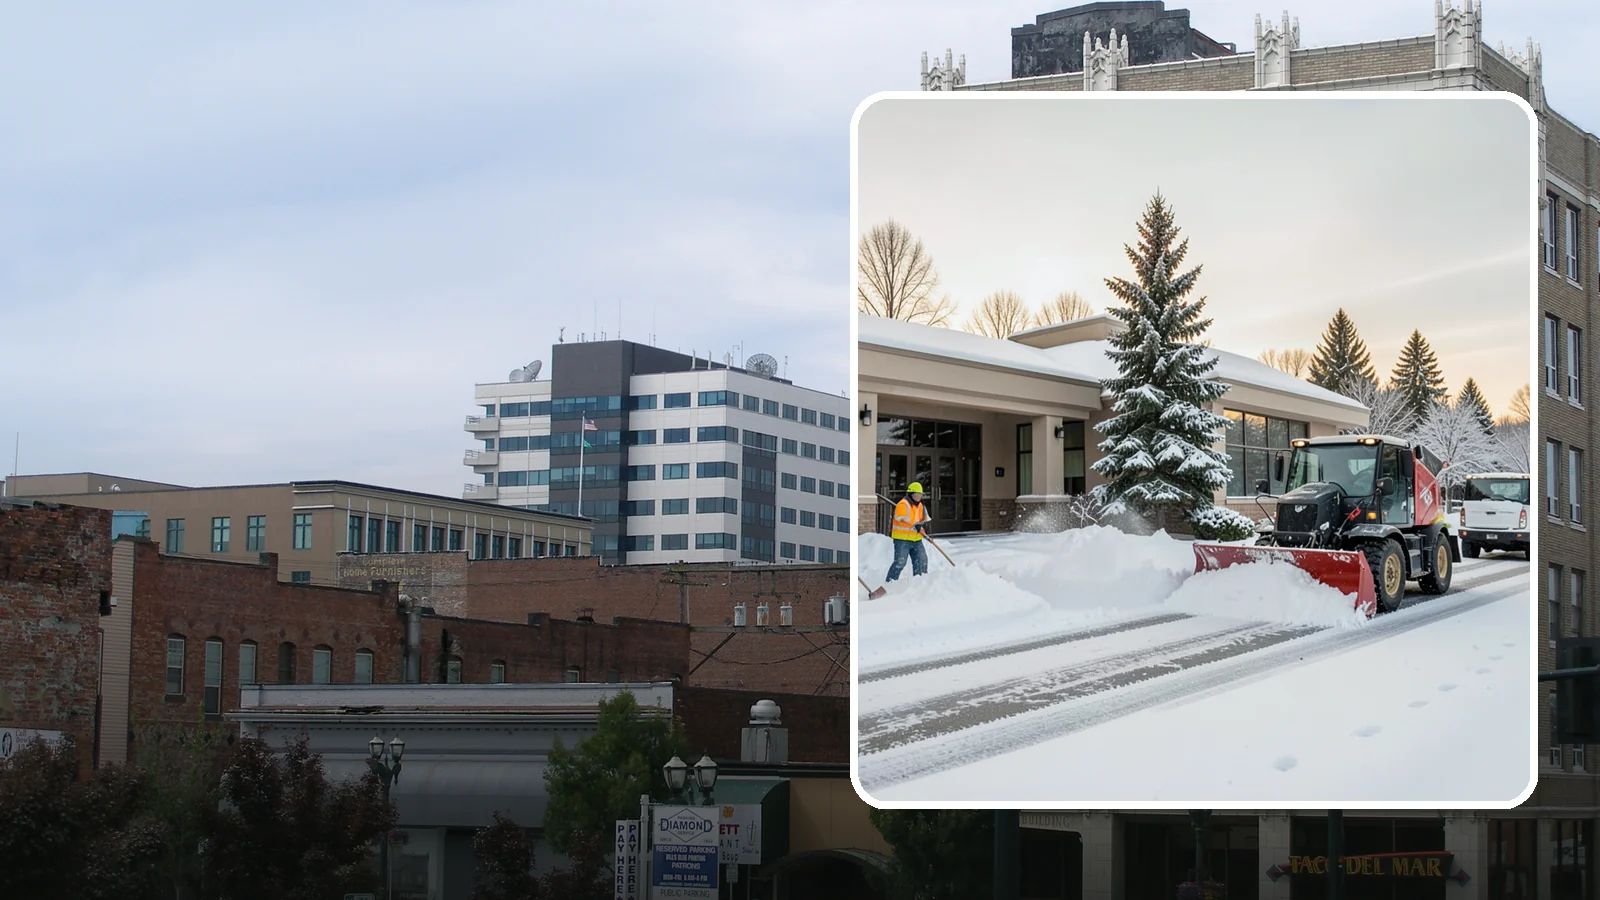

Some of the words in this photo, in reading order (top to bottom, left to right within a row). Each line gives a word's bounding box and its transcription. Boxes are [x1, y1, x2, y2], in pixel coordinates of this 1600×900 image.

[343, 568, 367, 577] Home
[370, 566, 427, 576] Furnishers
[660, 818, 713, 832] DIAMOND
[1022, 815, 1070, 828] BUILDING
[719, 823, 740, 835] ETT
[617, 825, 625, 852] PAY
[628, 824, 636, 852] PAY
[719, 839, 740, 848] ANT
[656, 845, 688, 853] RESERVED
[689, 846, 716, 854] PARKING
[721, 851, 739, 862] Soup
[671, 862, 701, 870] PATRONS
[1346, 856, 1385, 875] DEL
[1393, 857, 1442, 877] MAR
[616, 856, 624, 893] HERE
[627, 855, 636, 893] HERE
[660, 888, 682, 897] PUBLIC
[684, 889, 710, 898] PARKING
